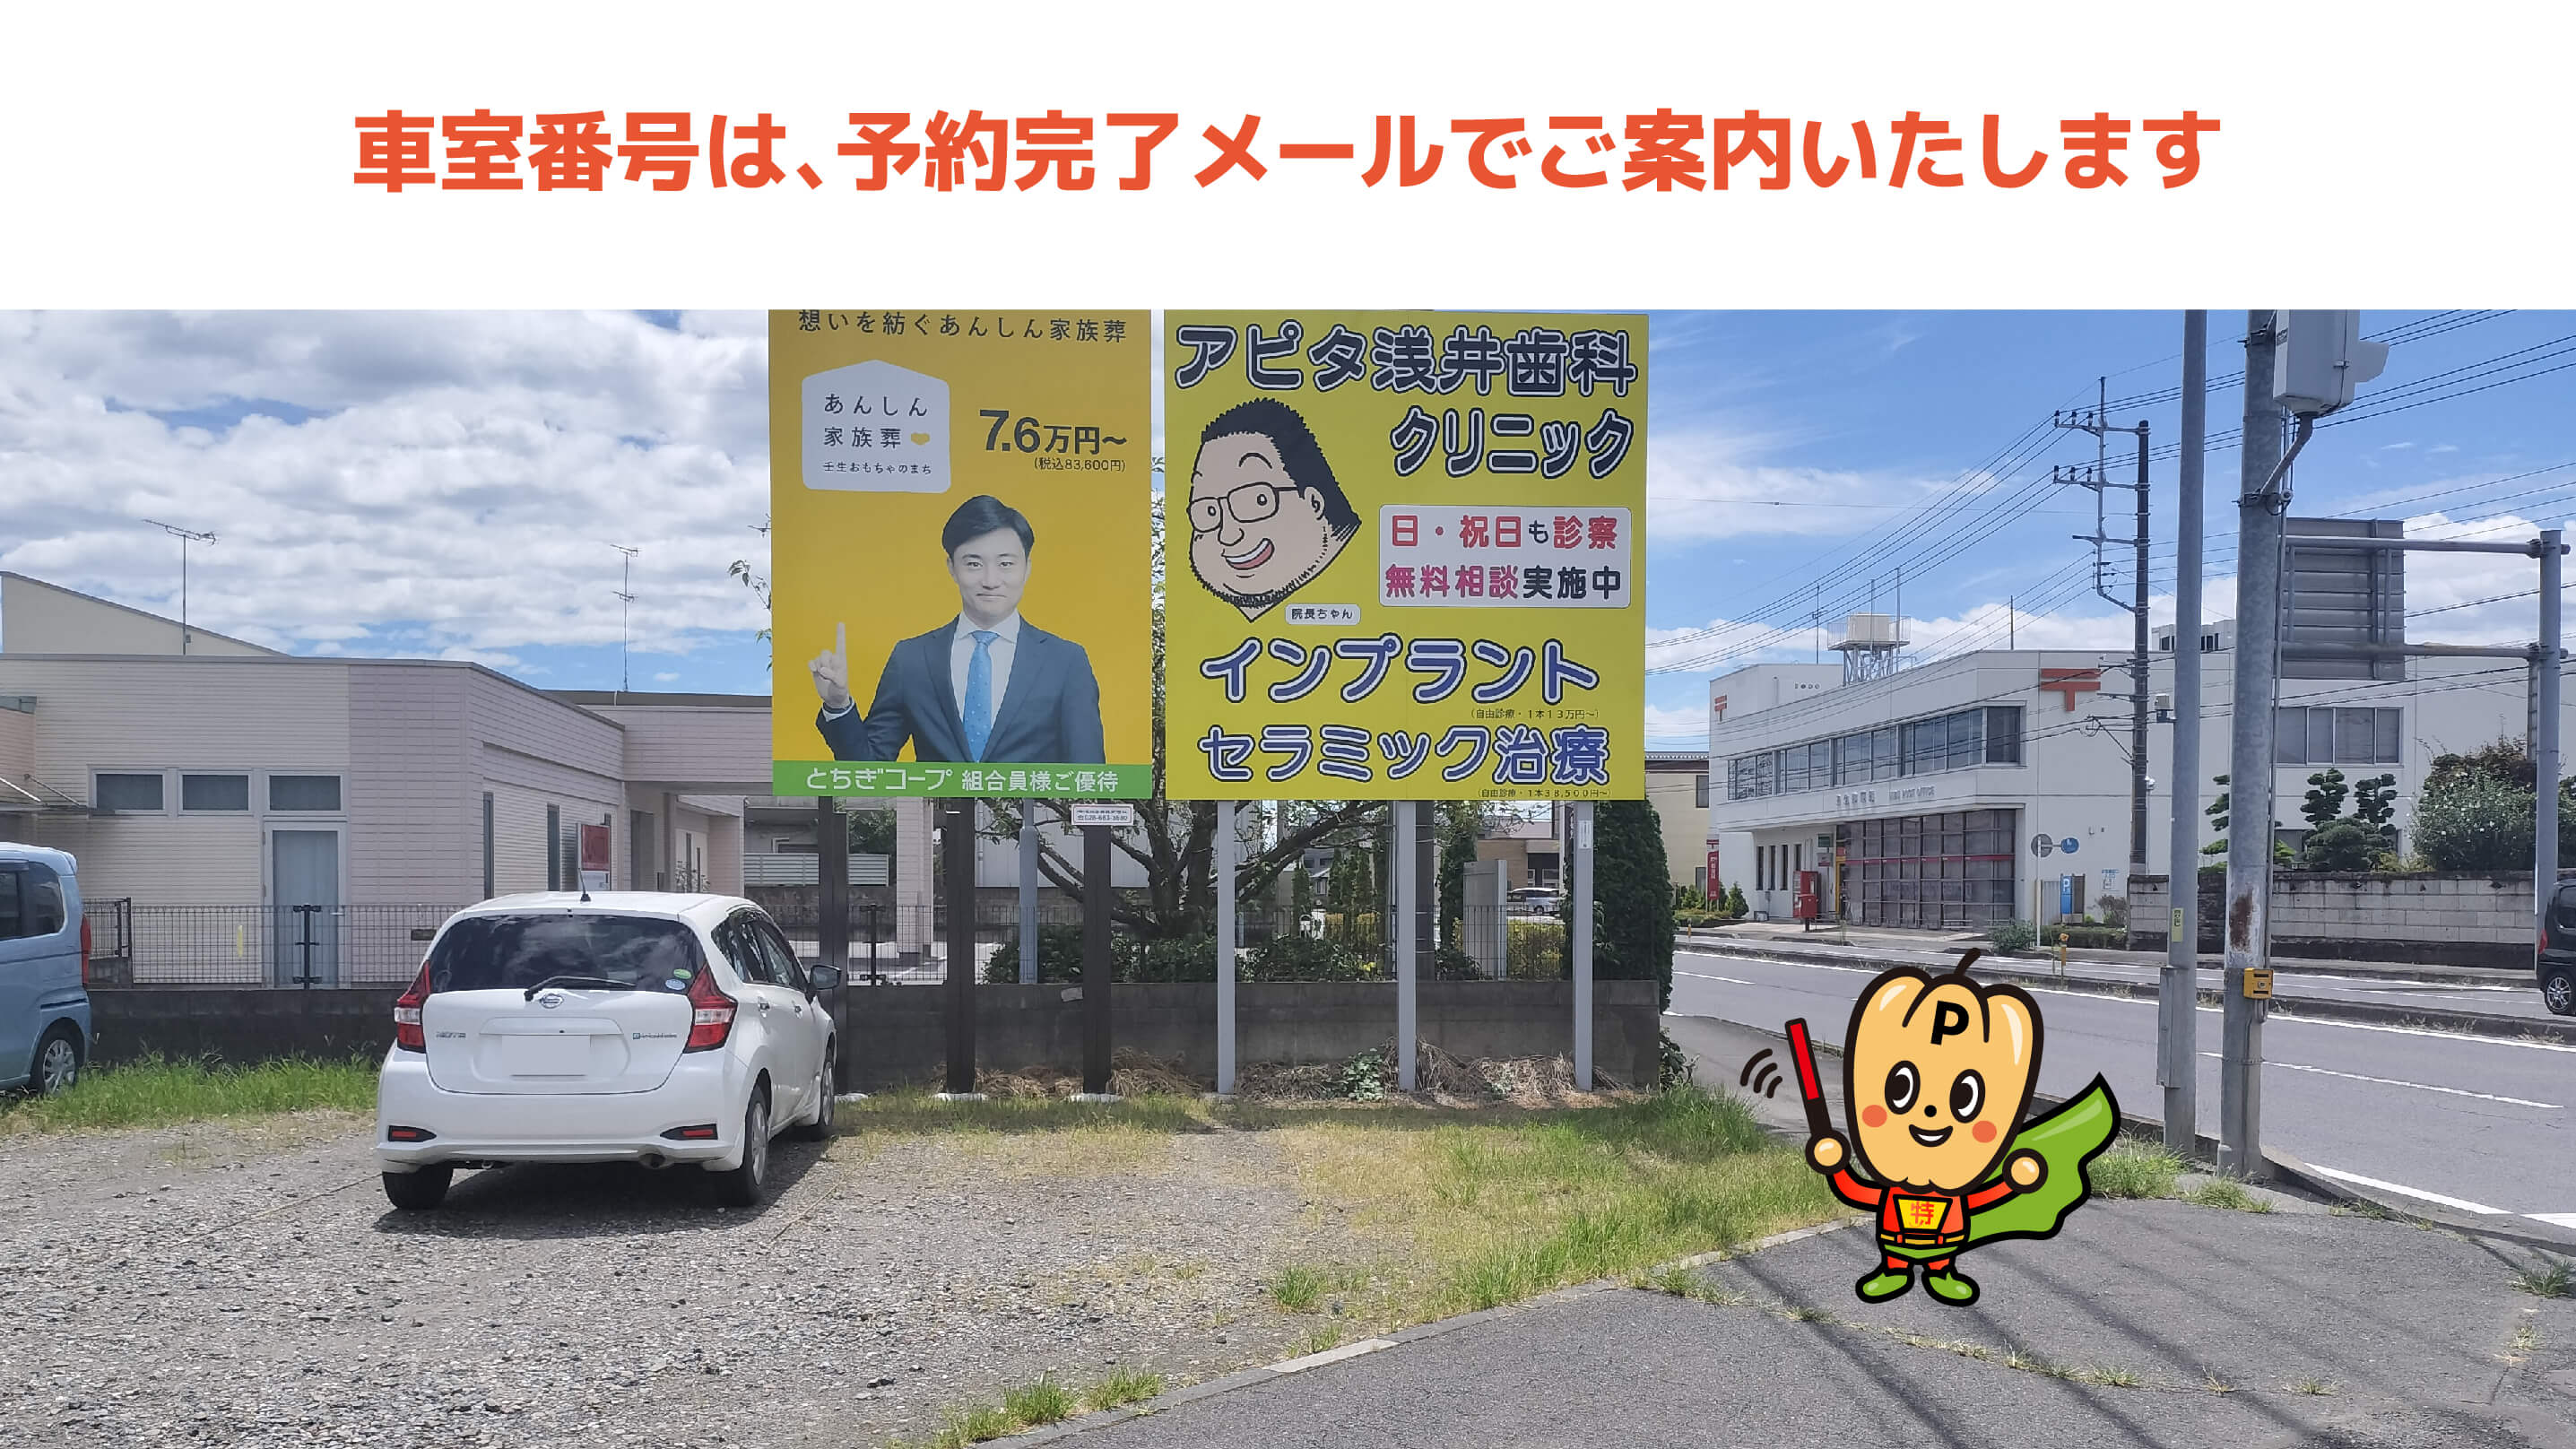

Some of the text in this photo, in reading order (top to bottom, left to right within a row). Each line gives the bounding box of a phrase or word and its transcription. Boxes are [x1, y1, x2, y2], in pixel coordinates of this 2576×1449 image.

[798, 309, 1127, 343] 想いを紡ぐあんしん家族葬
[1175, 320, 1637, 396] アピタ浅井歯科
[824, 394, 928, 417] あんしん
[824, 427, 902, 449] 家族葬
[1391, 406, 1635, 479] クリニック
[823, 460, 932, 475] 壬生おもちゃのまち
[1392, 515, 1618, 549] 日・祝日も診察
[1385, 565, 1621, 600] 無料相談実施中
[1291, 607, 1353, 620] 院長ちゃん
[1200, 632, 1600, 705] インプラント
[1198, 724, 1609, 785] セラミック治療
[806, 768, 1119, 793] とちぎコープ 組合員様ご優待
